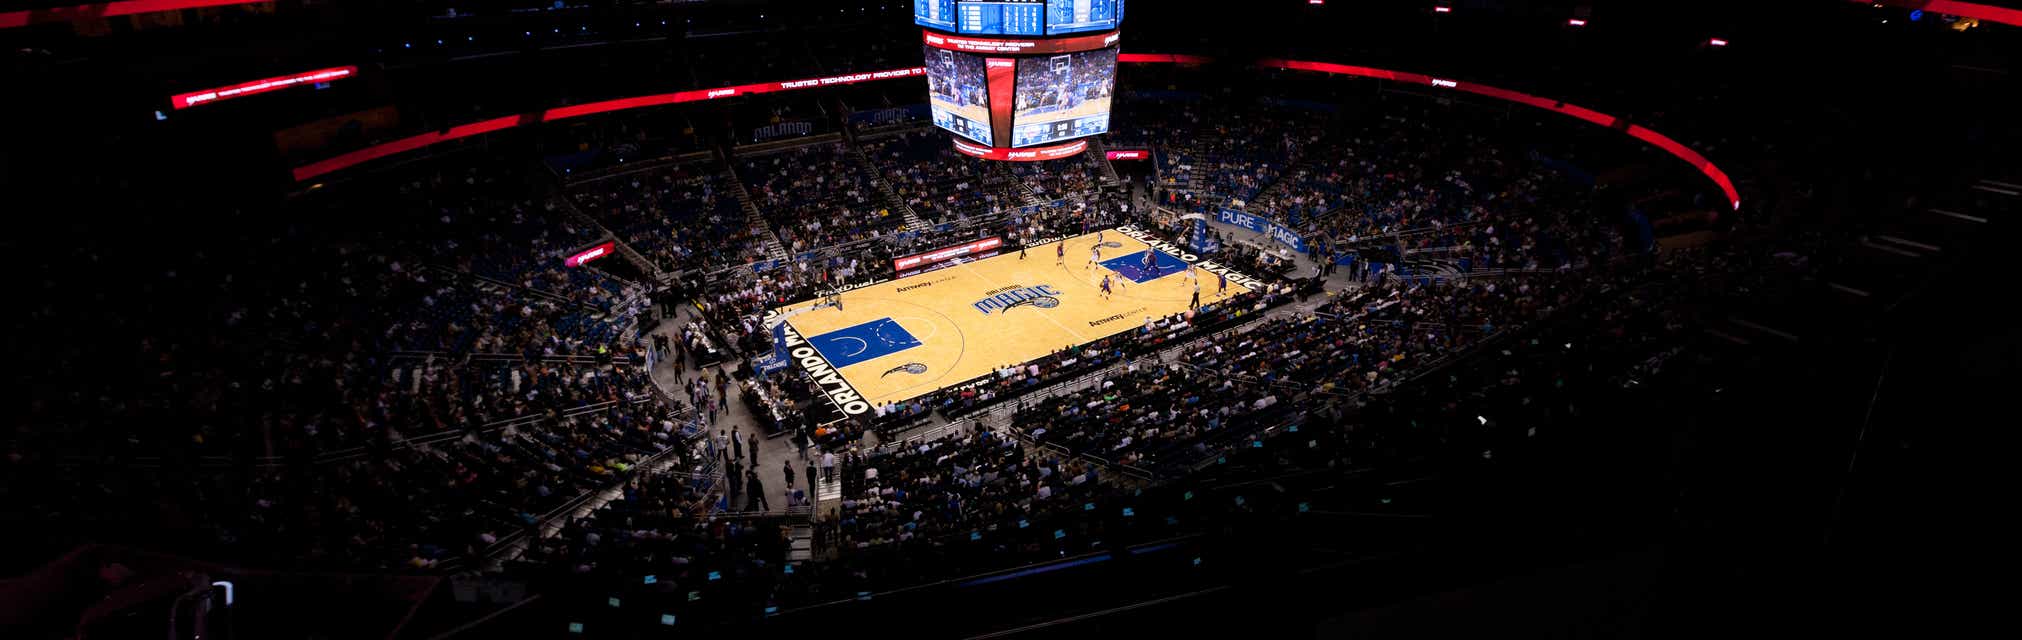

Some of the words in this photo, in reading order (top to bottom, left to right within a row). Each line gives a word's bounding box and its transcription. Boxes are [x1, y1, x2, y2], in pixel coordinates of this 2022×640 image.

[781, 79, 818, 89] TRUSTED
[820, 73, 872, 84] TECHNOLOGY
[873, 69, 910, 79] PROVIDER
[1222, 211, 1255, 229] PURE
[1268, 223, 1299, 249] MAGIC
[1116, 226, 1198, 262] ORLANDO
[1196, 260, 1263, 290] MAGIC
[972, 284, 1060, 316] MAGIC
[792, 347, 869, 415] ORLANDO
